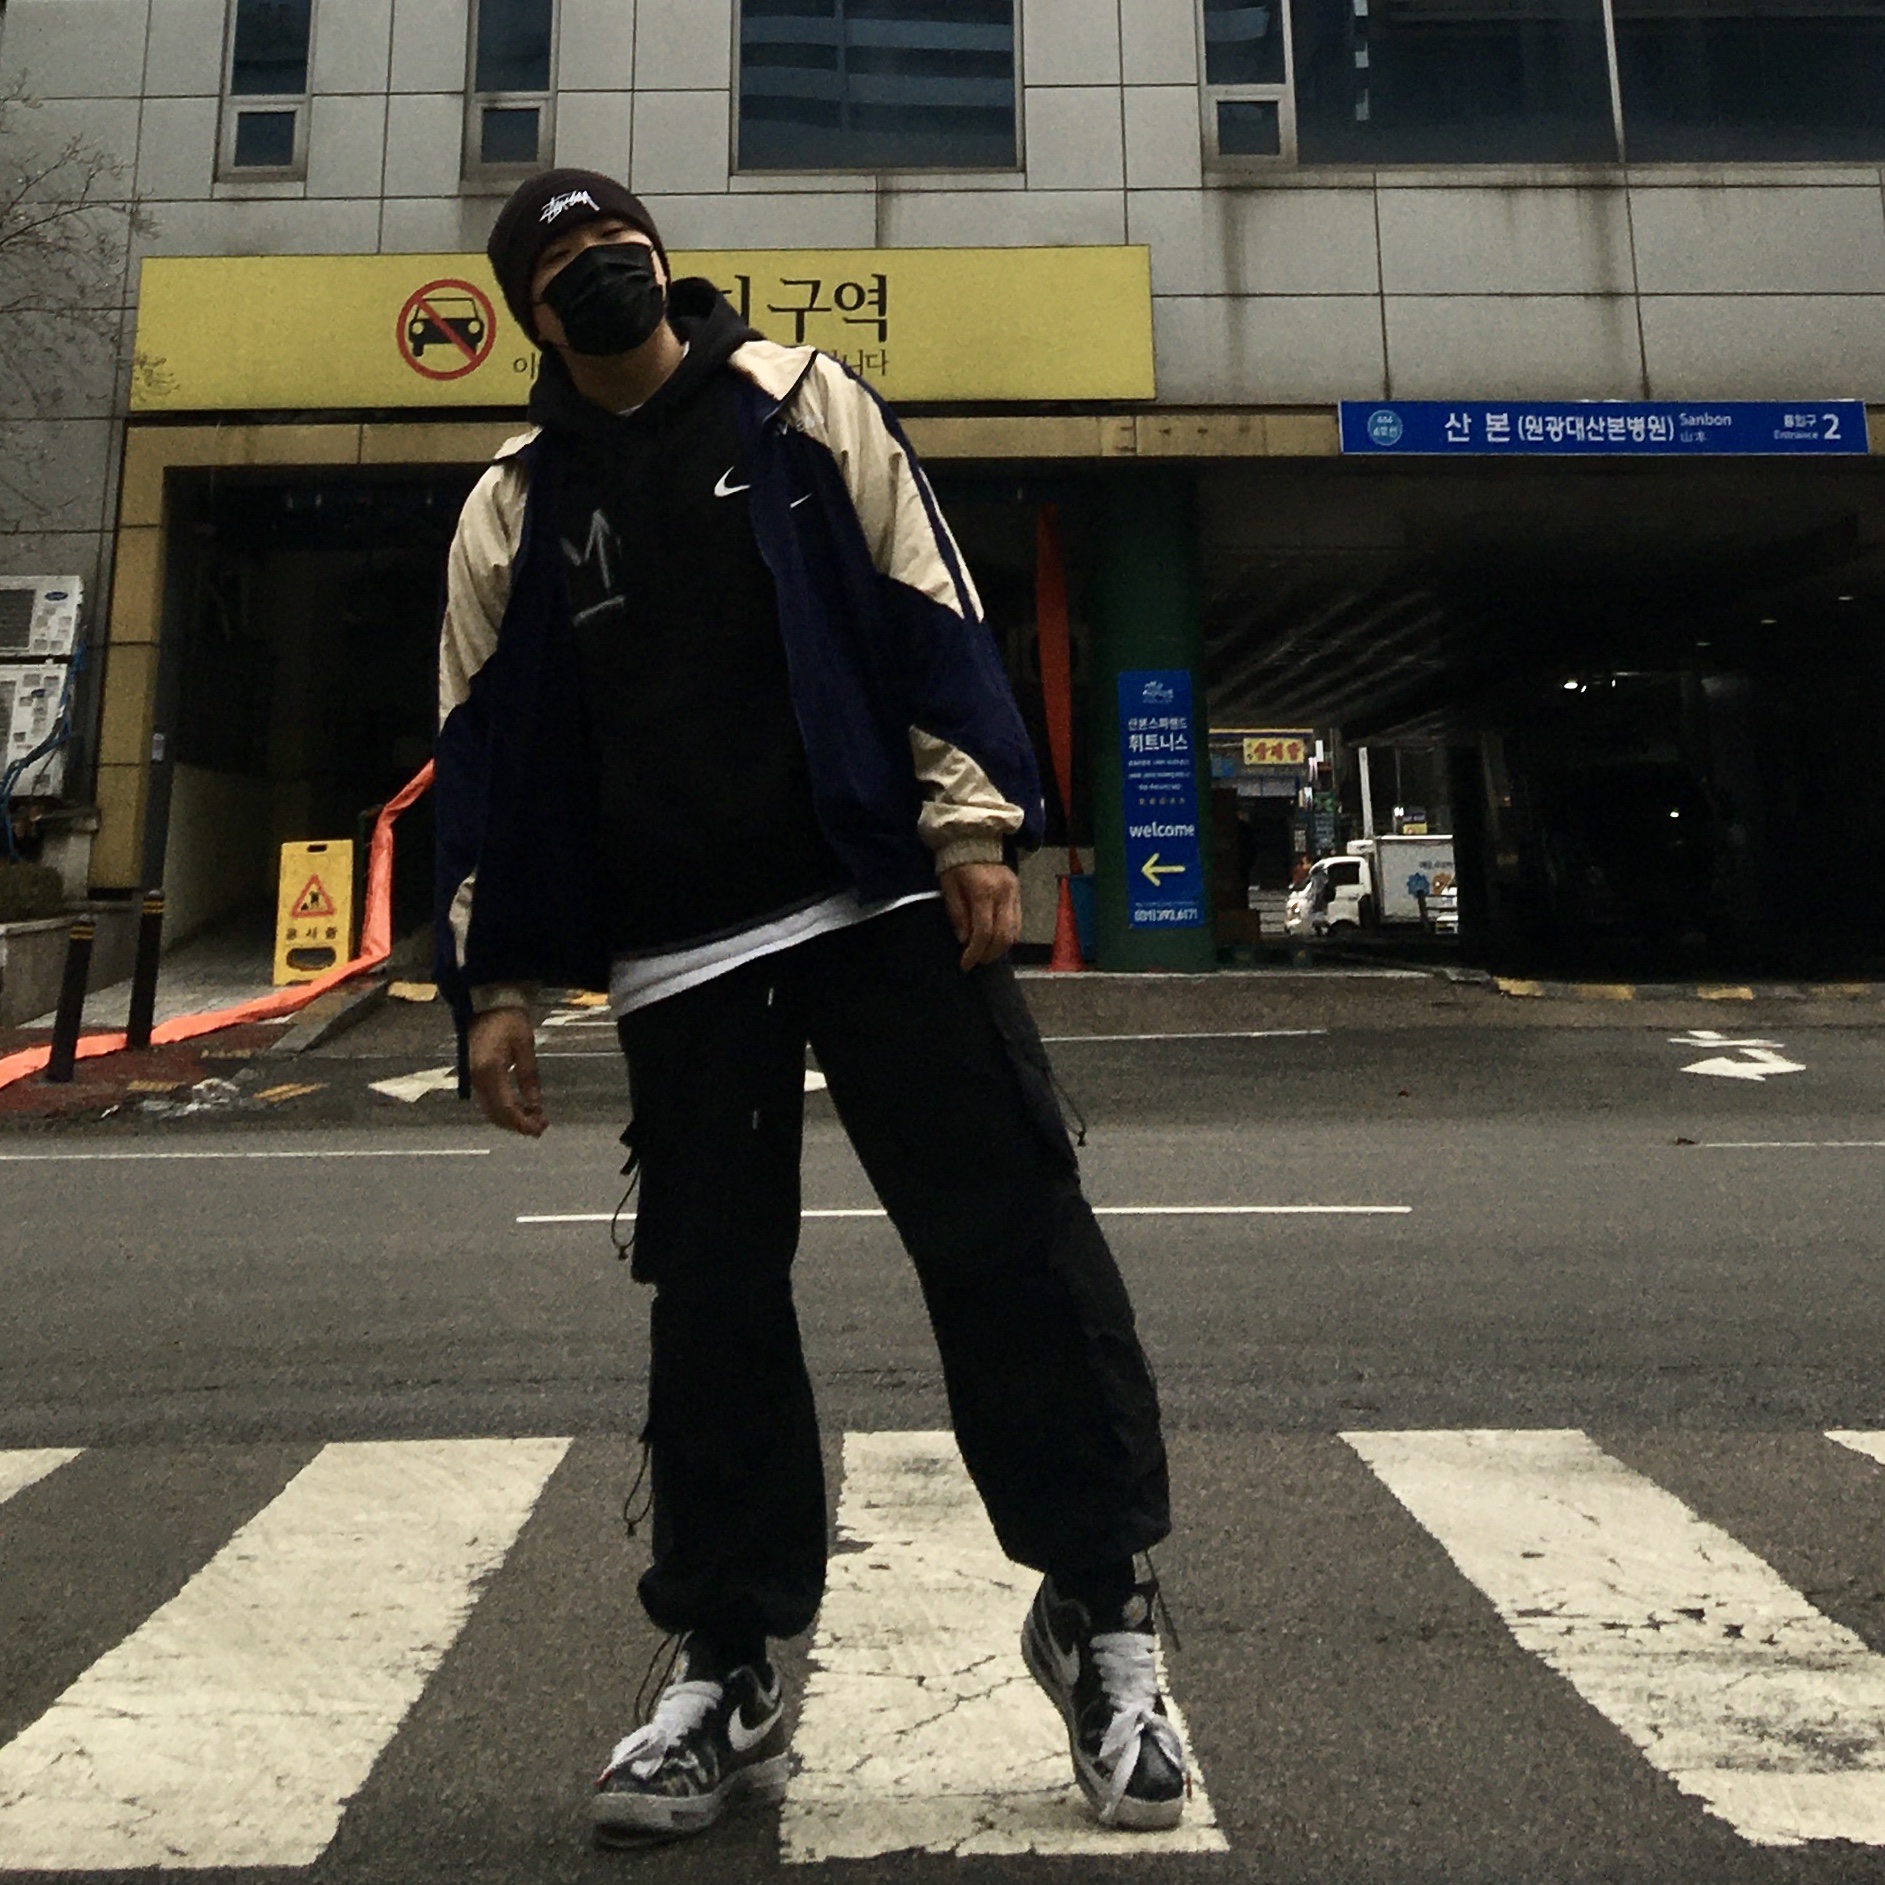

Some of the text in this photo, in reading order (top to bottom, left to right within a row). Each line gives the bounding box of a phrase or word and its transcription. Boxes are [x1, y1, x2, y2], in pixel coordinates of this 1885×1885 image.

[1679, 412, 1732, 426] Sanbon
[1822, 413, 1842, 440] 2
[1129, 821, 1195, 838] welcome
